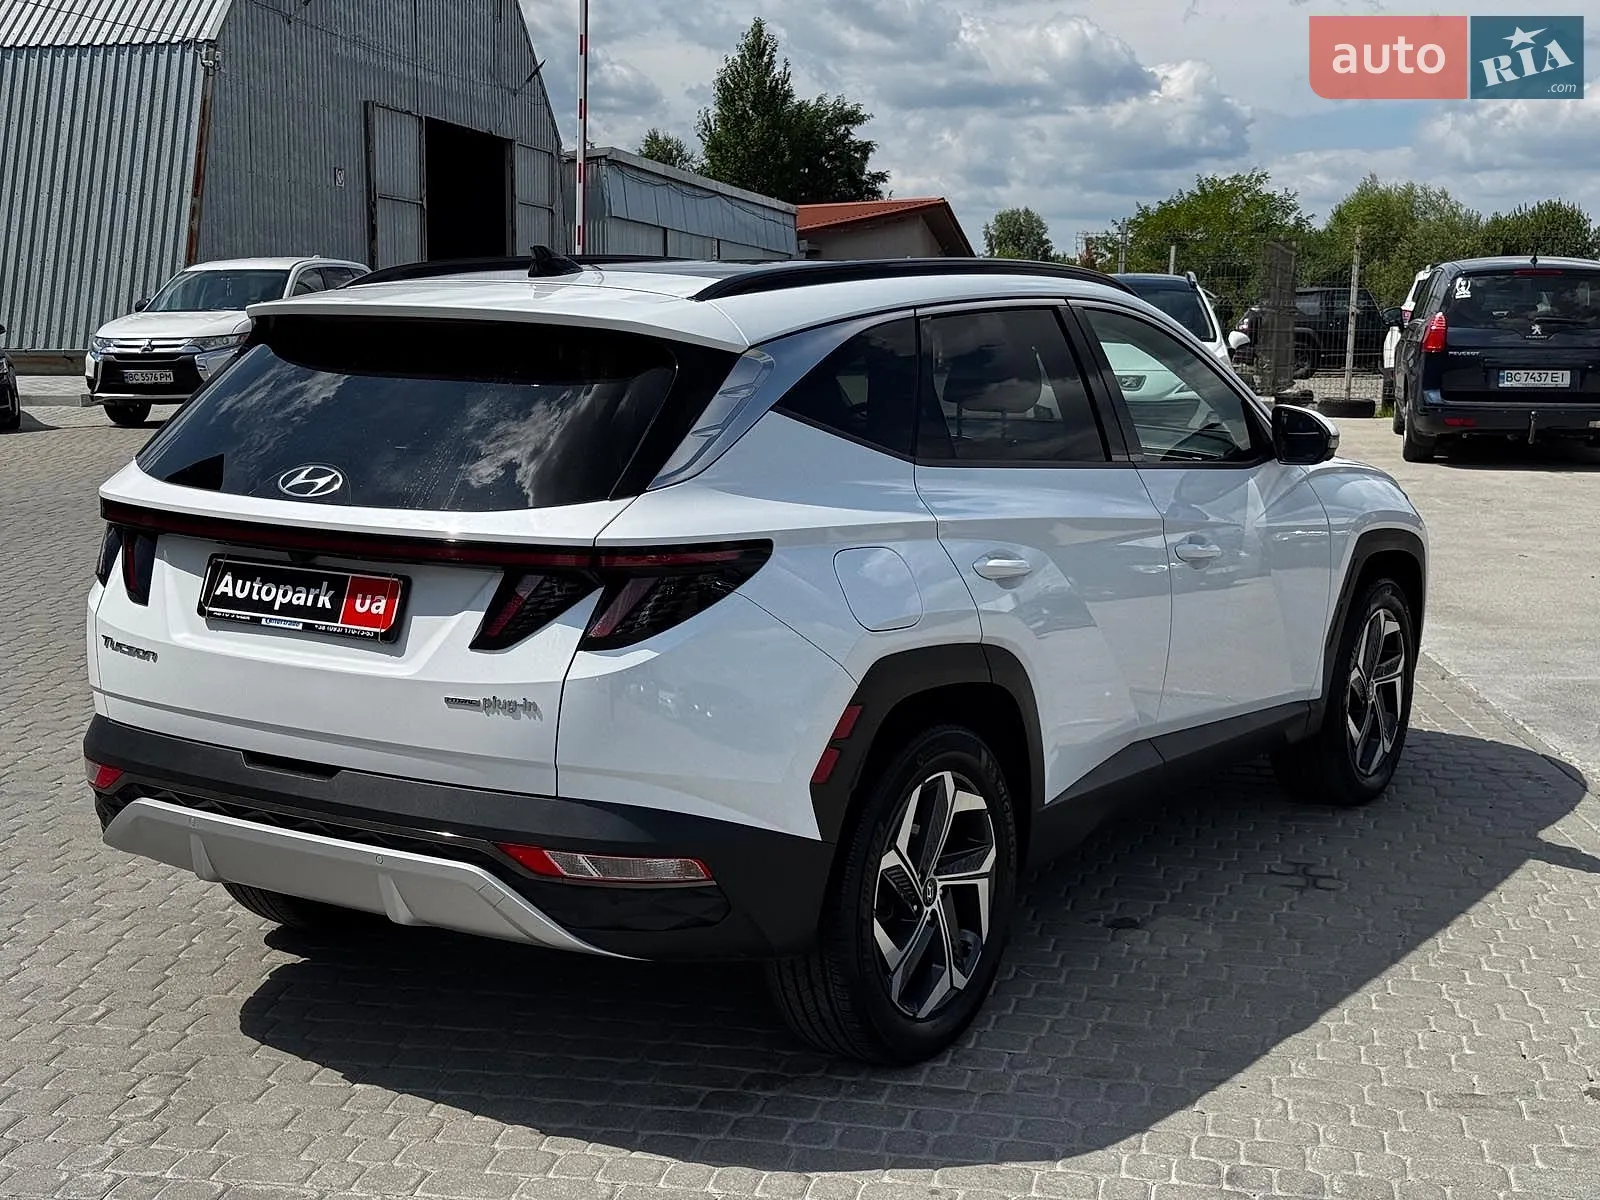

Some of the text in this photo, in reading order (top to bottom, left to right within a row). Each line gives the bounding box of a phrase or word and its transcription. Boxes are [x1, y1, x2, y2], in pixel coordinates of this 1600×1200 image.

[1524, 372, 1549, 383] 7437
[215, 572, 387, 615] Autopark ua
[482, 695, 540, 715] plug-in
